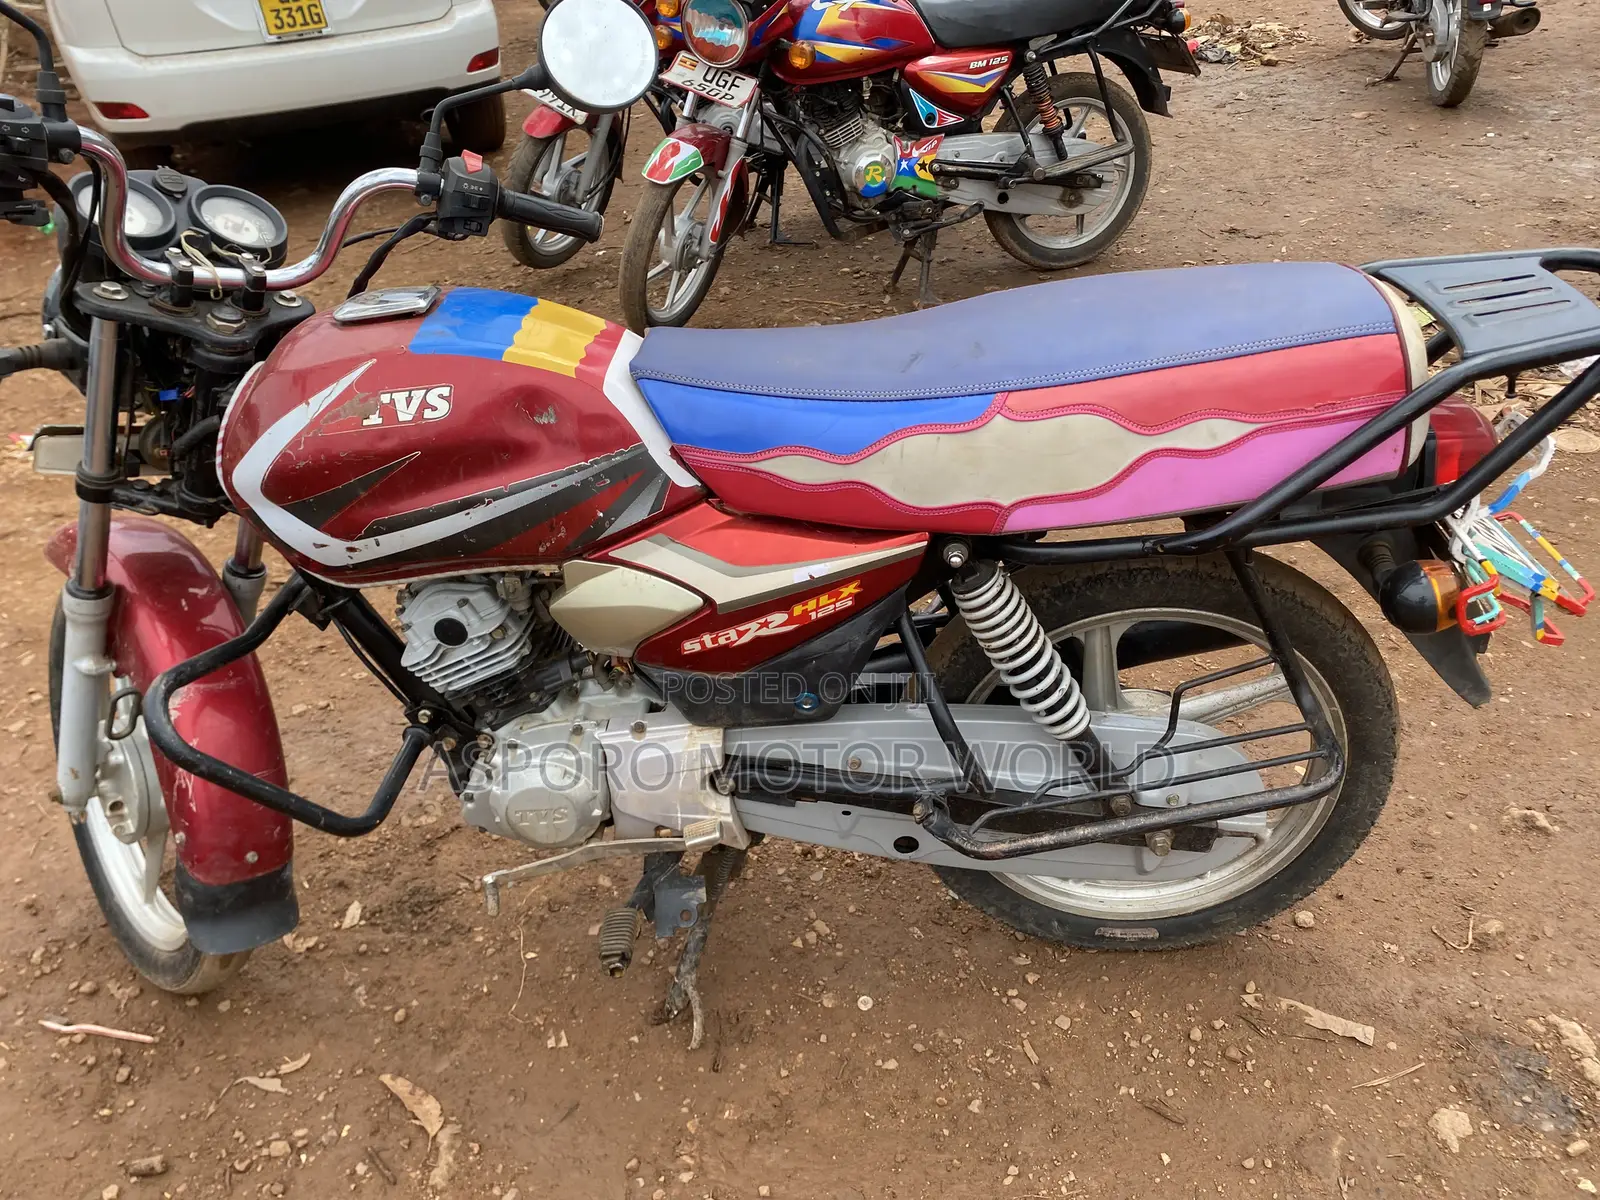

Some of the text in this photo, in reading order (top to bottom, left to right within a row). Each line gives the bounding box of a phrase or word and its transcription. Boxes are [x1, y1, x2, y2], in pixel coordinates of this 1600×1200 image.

[269, 3, 322, 30] 331G
[969, 55, 1009, 70] BM 125
[702, 66, 746, 91] UGF
[362, 386, 451, 426] TVS
[793, 580, 861, 617] HLX
[808, 597, 853, 620] 125
[514, 807, 568, 826] TVS
